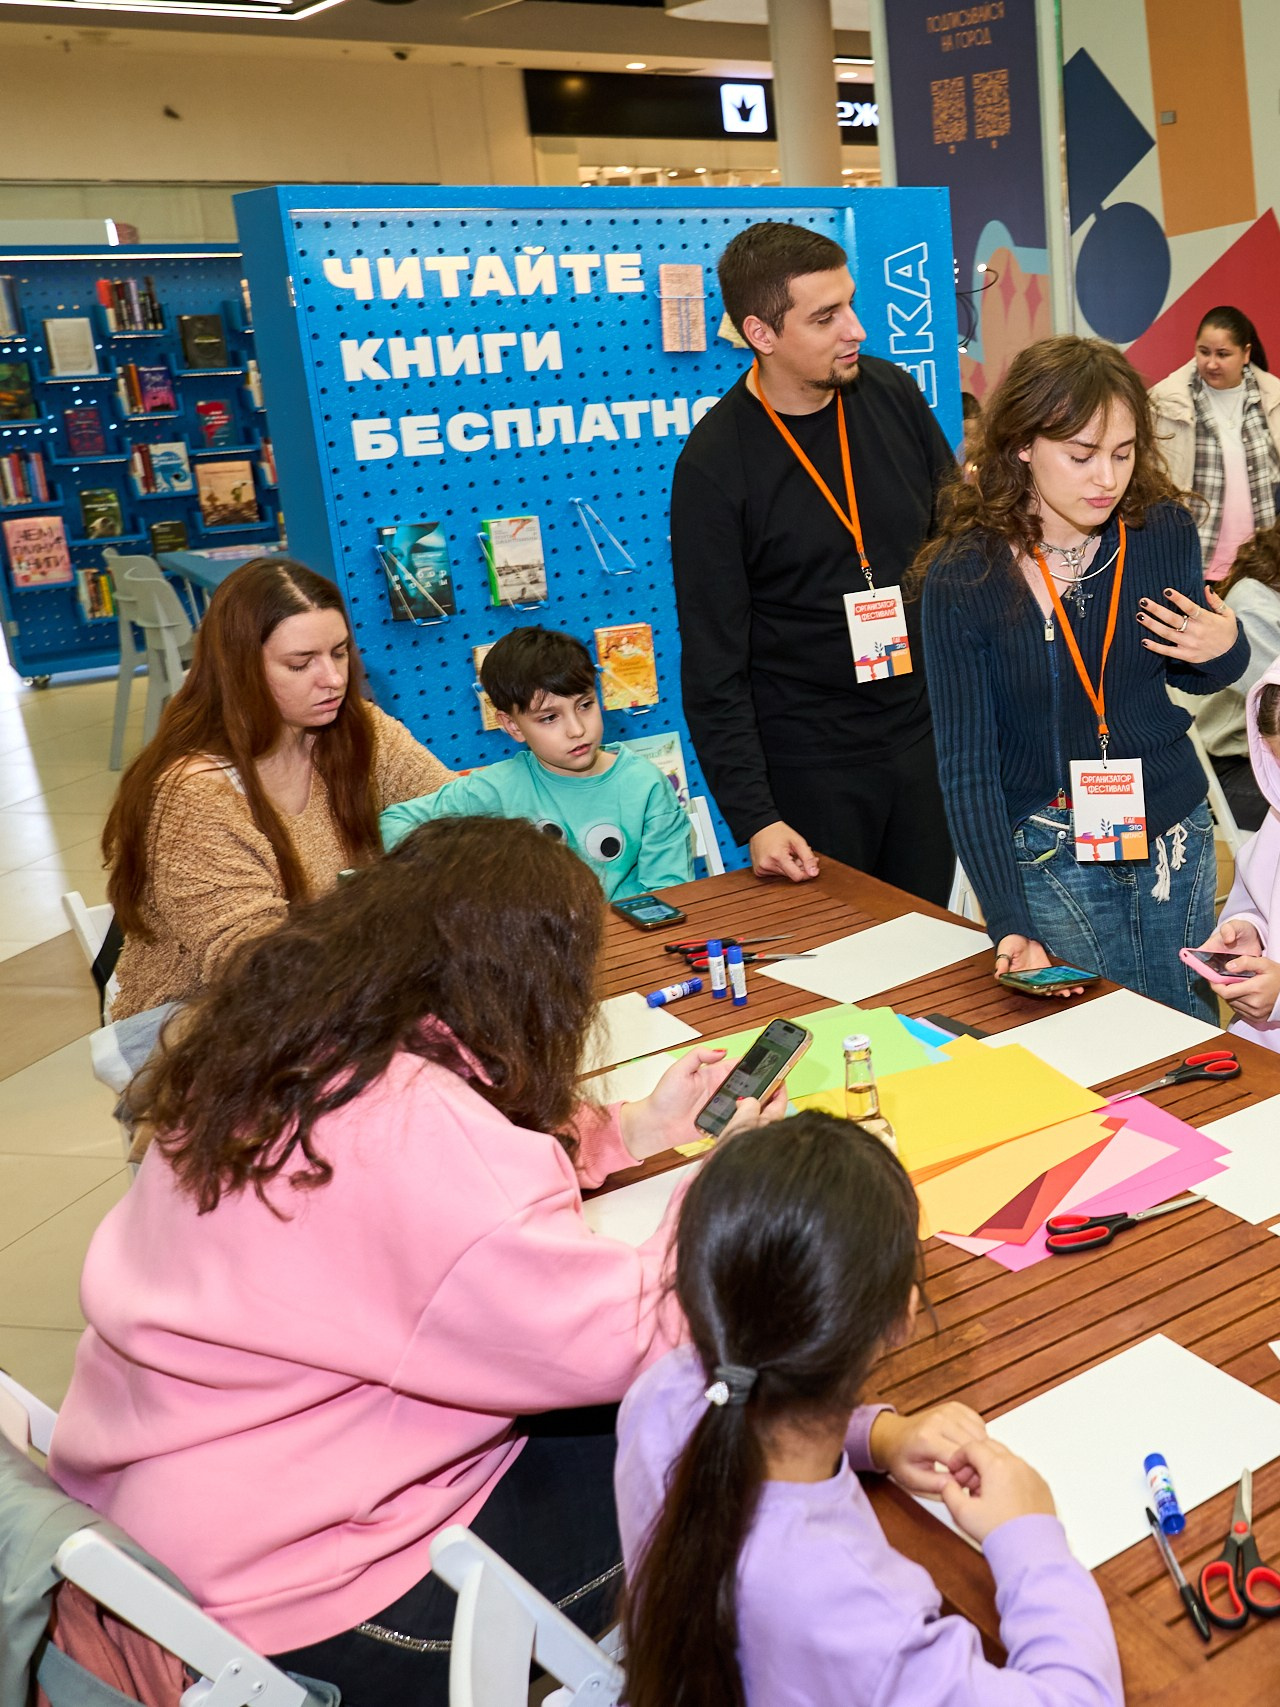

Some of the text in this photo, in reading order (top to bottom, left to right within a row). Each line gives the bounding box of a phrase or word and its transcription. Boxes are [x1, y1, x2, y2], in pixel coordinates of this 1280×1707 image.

[955, 27, 992, 49] ГОРОД
[323, 246, 645, 300] ЧИТАЙТЕ
[339, 331, 564, 381] КНИГИ
[855, 600, 895, 614] ОРГАНИЗАТОР
[861, 608, 895, 621] ФЕСТИВАЛЯ
[1081, 774, 1132, 784] ОРГАНИЗАТОР
[1087, 784, 1131, 794] ФЕСТИВАЛЯ
